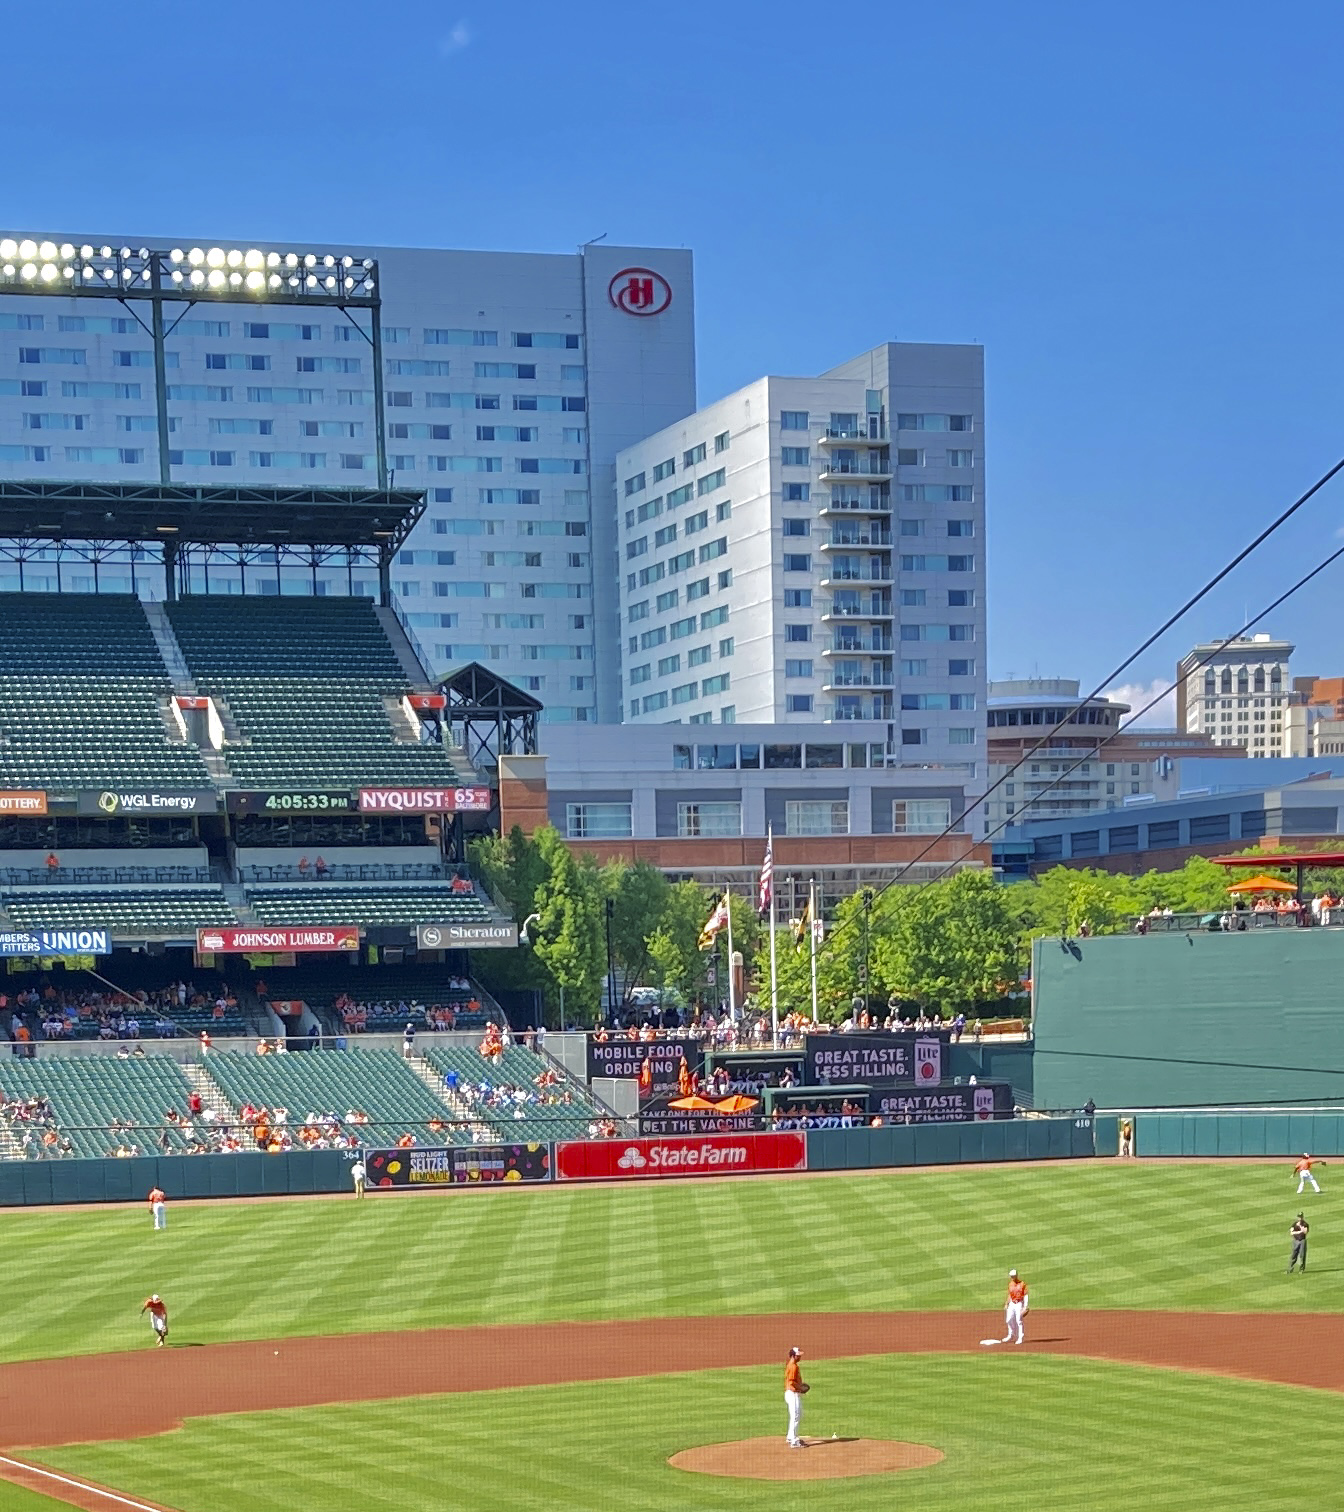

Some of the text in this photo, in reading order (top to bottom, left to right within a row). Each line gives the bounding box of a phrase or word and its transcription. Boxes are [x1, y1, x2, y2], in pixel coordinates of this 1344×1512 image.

[265, 795, 348, 810] 4:05:33 PM
[361, 789, 475, 810] NYQUIST 65
[449, 926, 512, 938] Sheraton
[42, 931, 106, 949] UNION
[232, 933, 288, 947] JOHNSON
[289, 932, 336, 946] LUMBER
[2, 943, 41, 952] FITTERS
[594, 1044, 684, 1059] MOBILE FOOD
[814, 1047, 938, 1064] GREAT TASTE. Lite
[605, 1061, 673, 1075] ORDEING
[815, 1063, 909, 1079] LESS FILLING.
[881, 1097, 923, 1110] GREAT
[671, 1119, 697, 1132] THE
[699, 1118, 755, 1131] VACCINE
[1074, 1119, 1090, 1129] 410
[342, 1150, 360, 1160] 364
[410, 1157, 449, 1171] SELTZER
